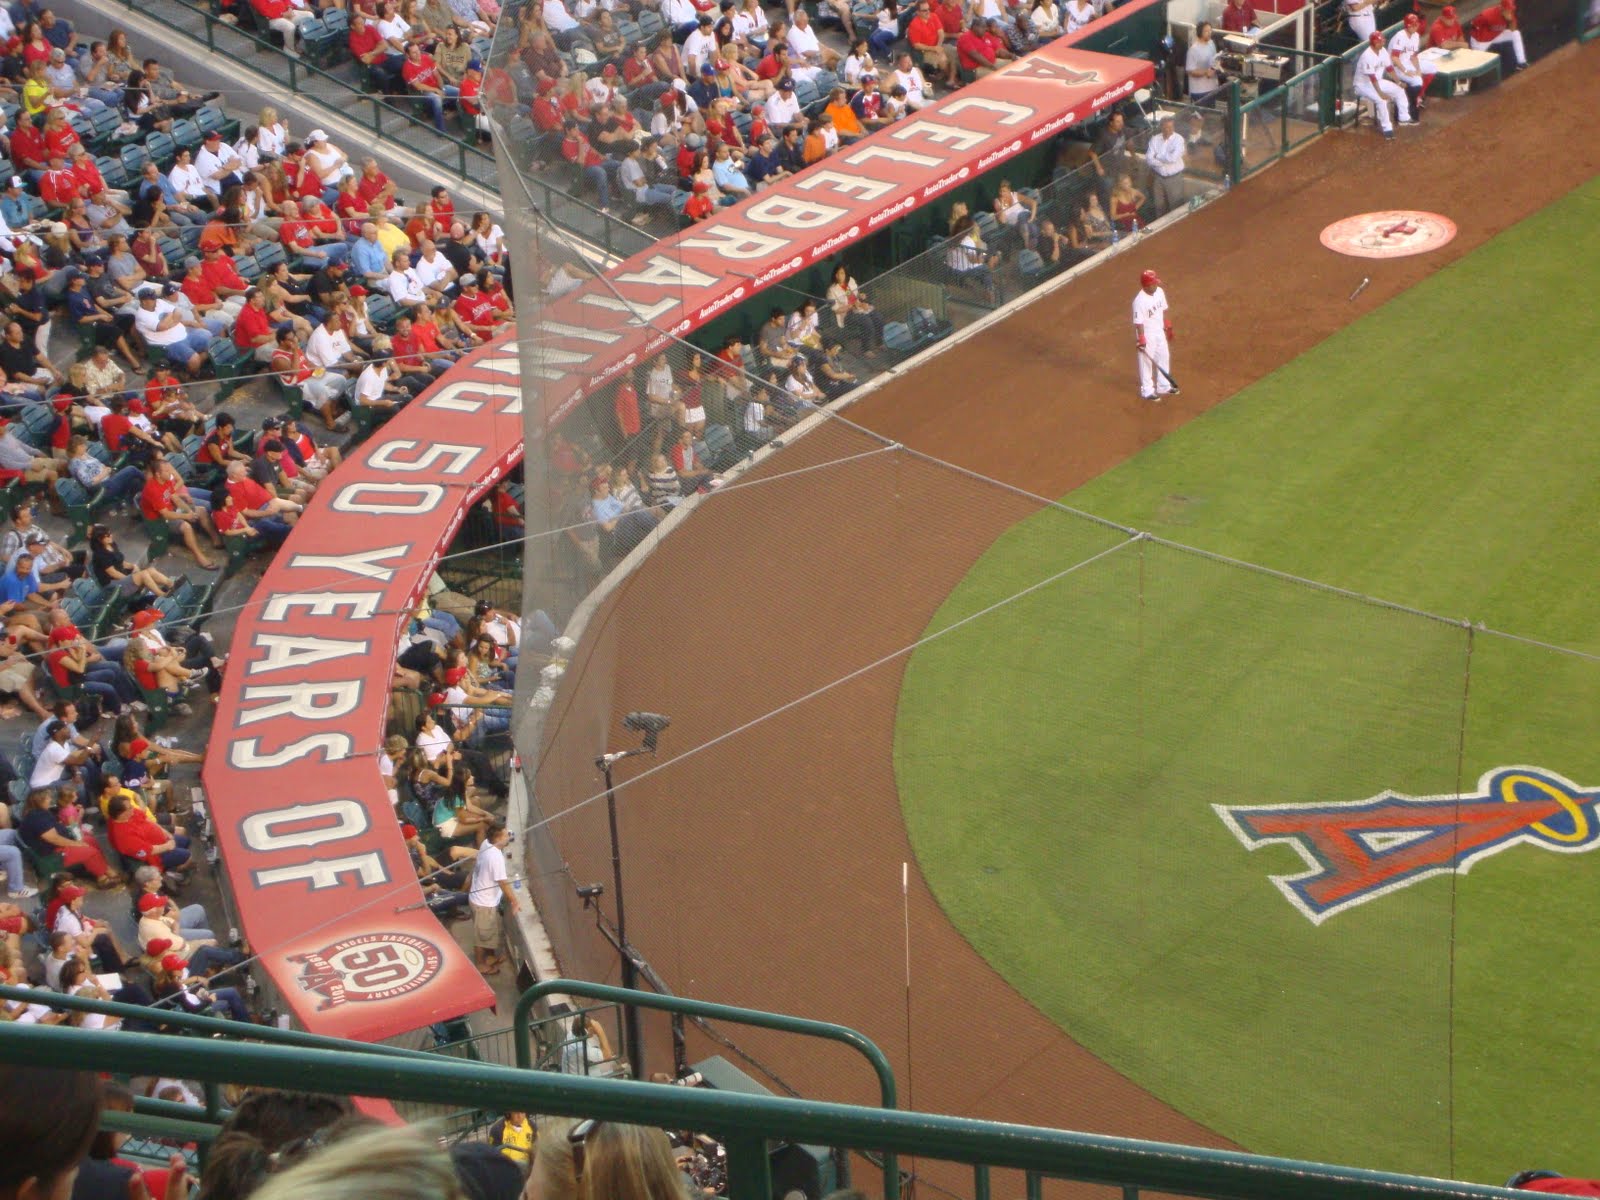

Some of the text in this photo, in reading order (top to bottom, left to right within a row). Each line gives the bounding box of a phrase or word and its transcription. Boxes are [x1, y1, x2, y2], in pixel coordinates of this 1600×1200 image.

[1092, 86, 1126, 108] AutoTrader
[1031, 116, 1066, 140] AutoTrader
[977, 145, 1013, 169] AutoTrader
[924, 171, 960, 197] AutoTrader
[868, 200, 905, 227] AutoTrader
[812, 231, 850, 257] AutoTrader
[330, 438, 484, 516] 50
[228, 542, 411, 770] YEARS
[240, 798, 389, 890] OF
[341, 943, 409, 988] 50
